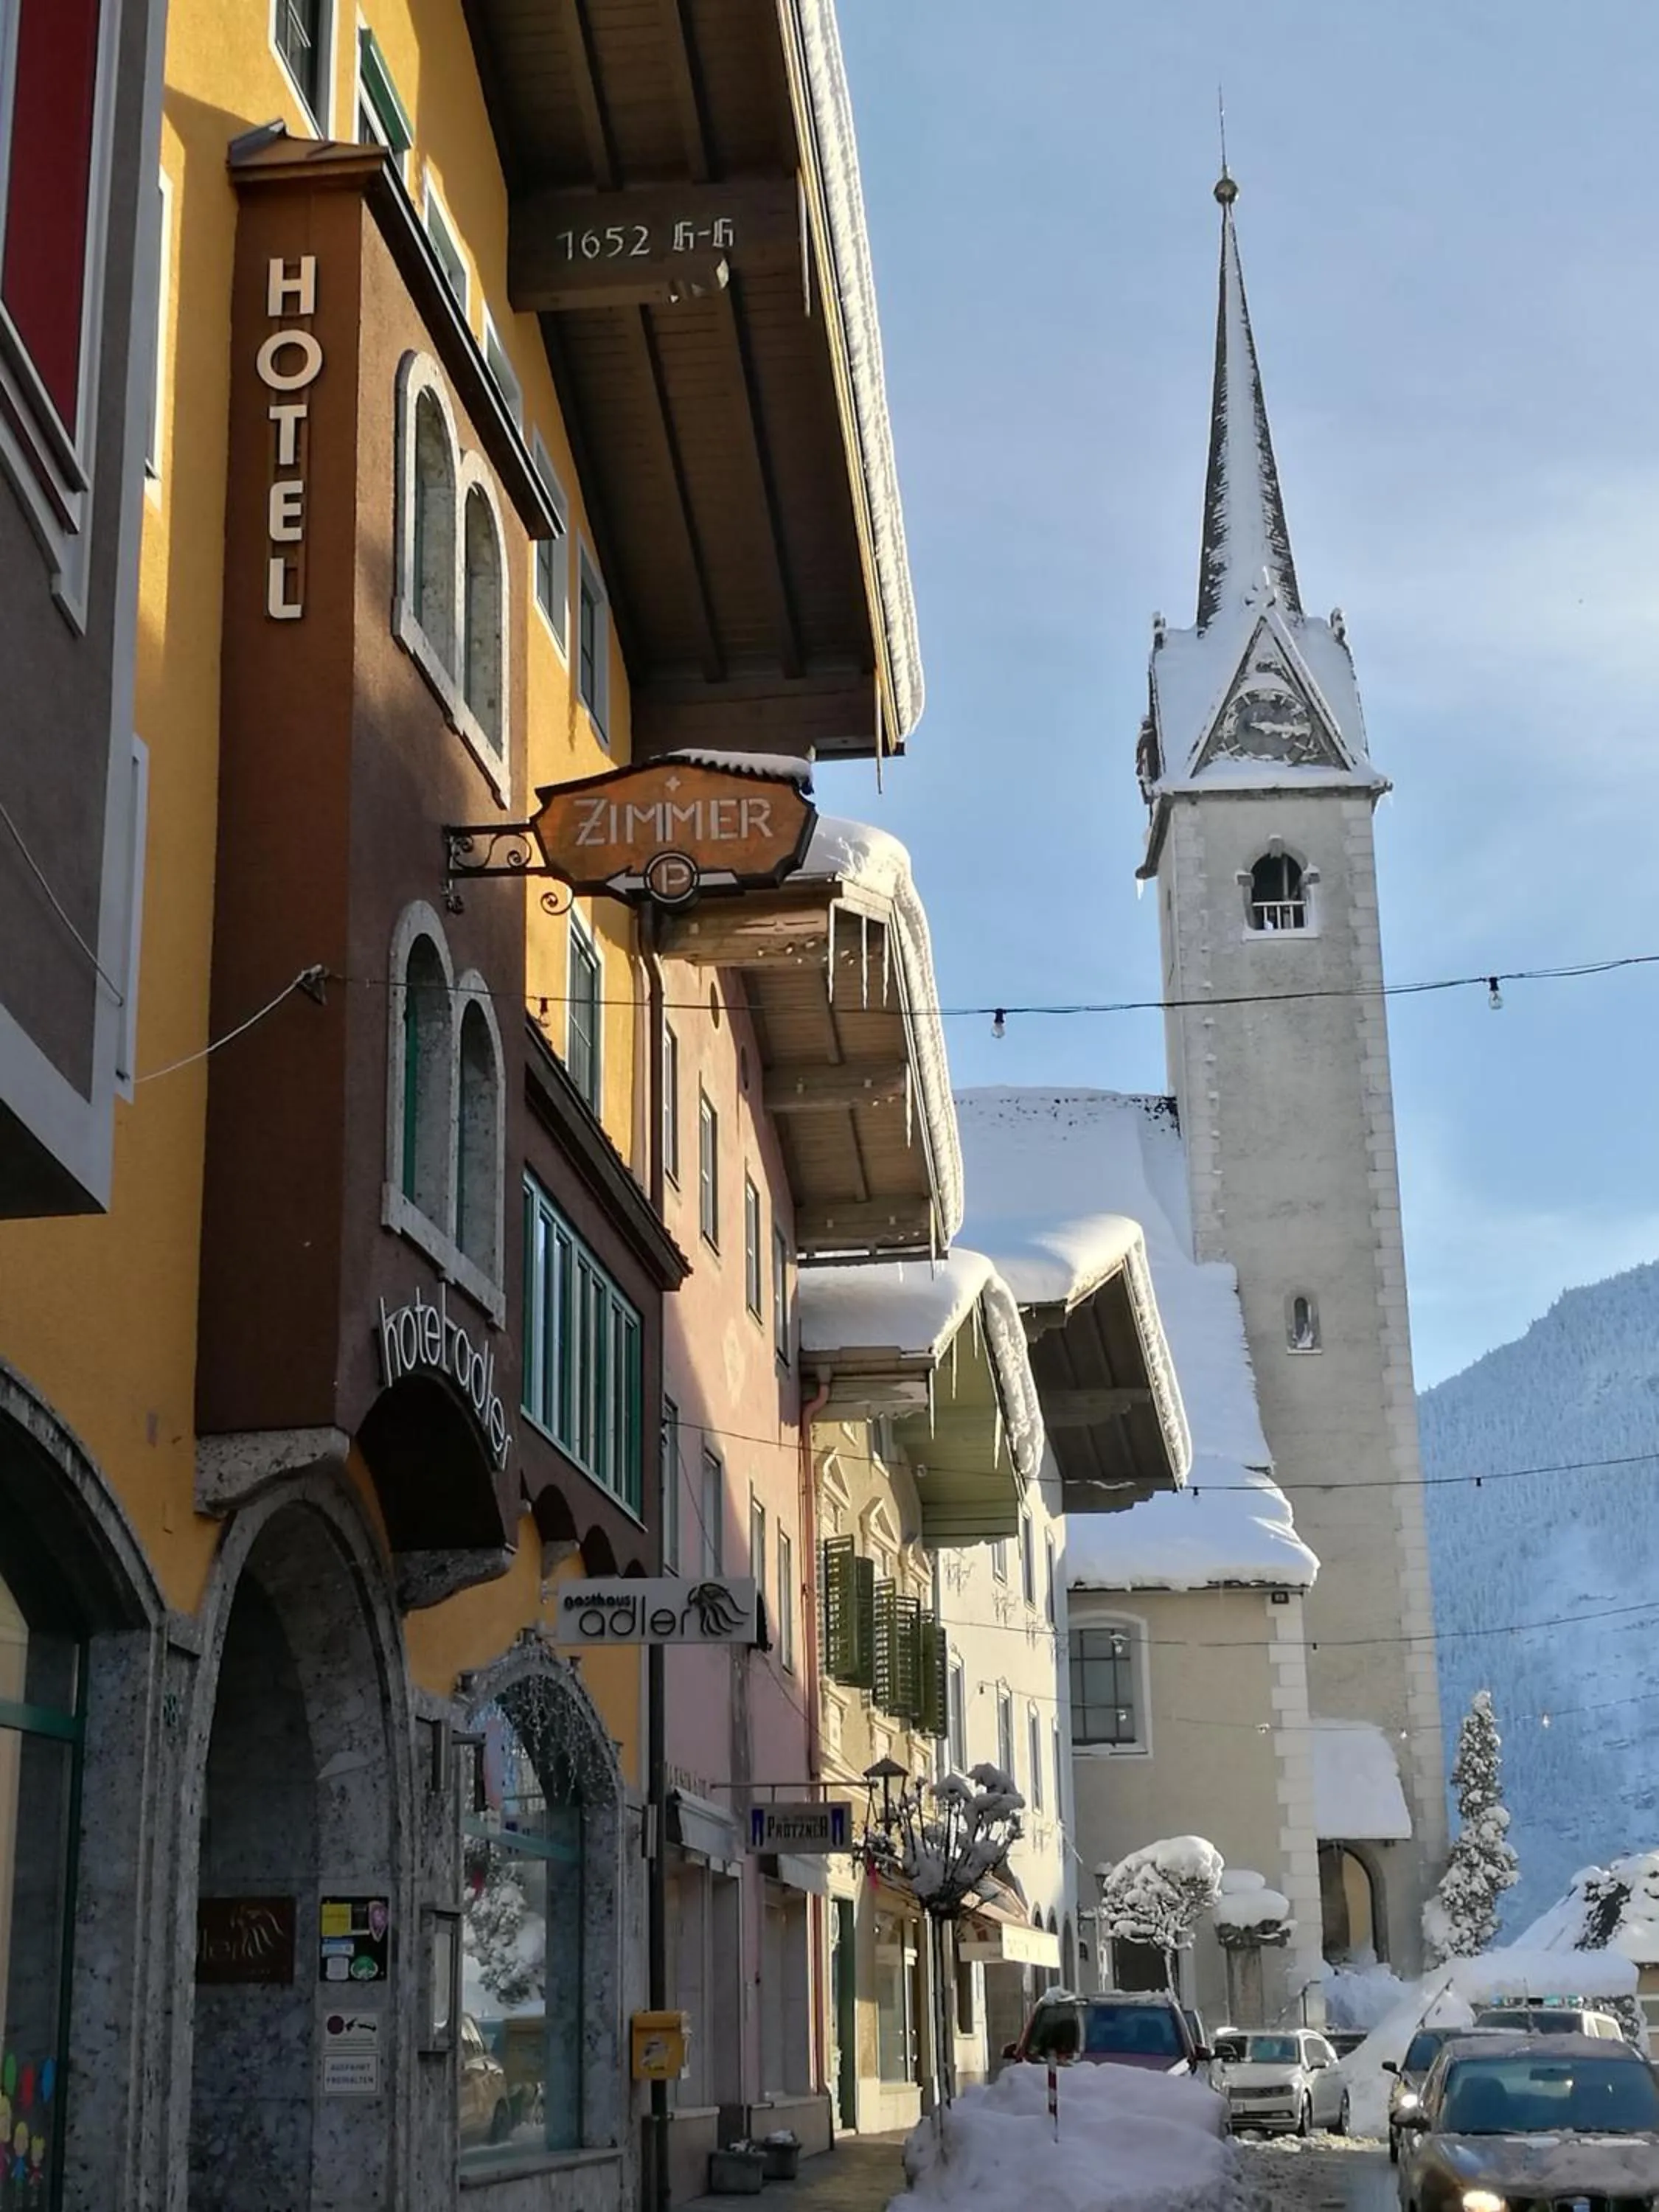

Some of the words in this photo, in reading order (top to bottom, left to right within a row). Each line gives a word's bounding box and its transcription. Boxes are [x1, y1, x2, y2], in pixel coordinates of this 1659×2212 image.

[556, 225, 651, 260] 1652
[256, 255, 323, 619] HOTEL
[573, 797, 773, 846] ZIMMER
[661, 863, 689, 893] P
[379, 1281, 453, 1388] hotel
[579, 1595, 691, 1636] adler
